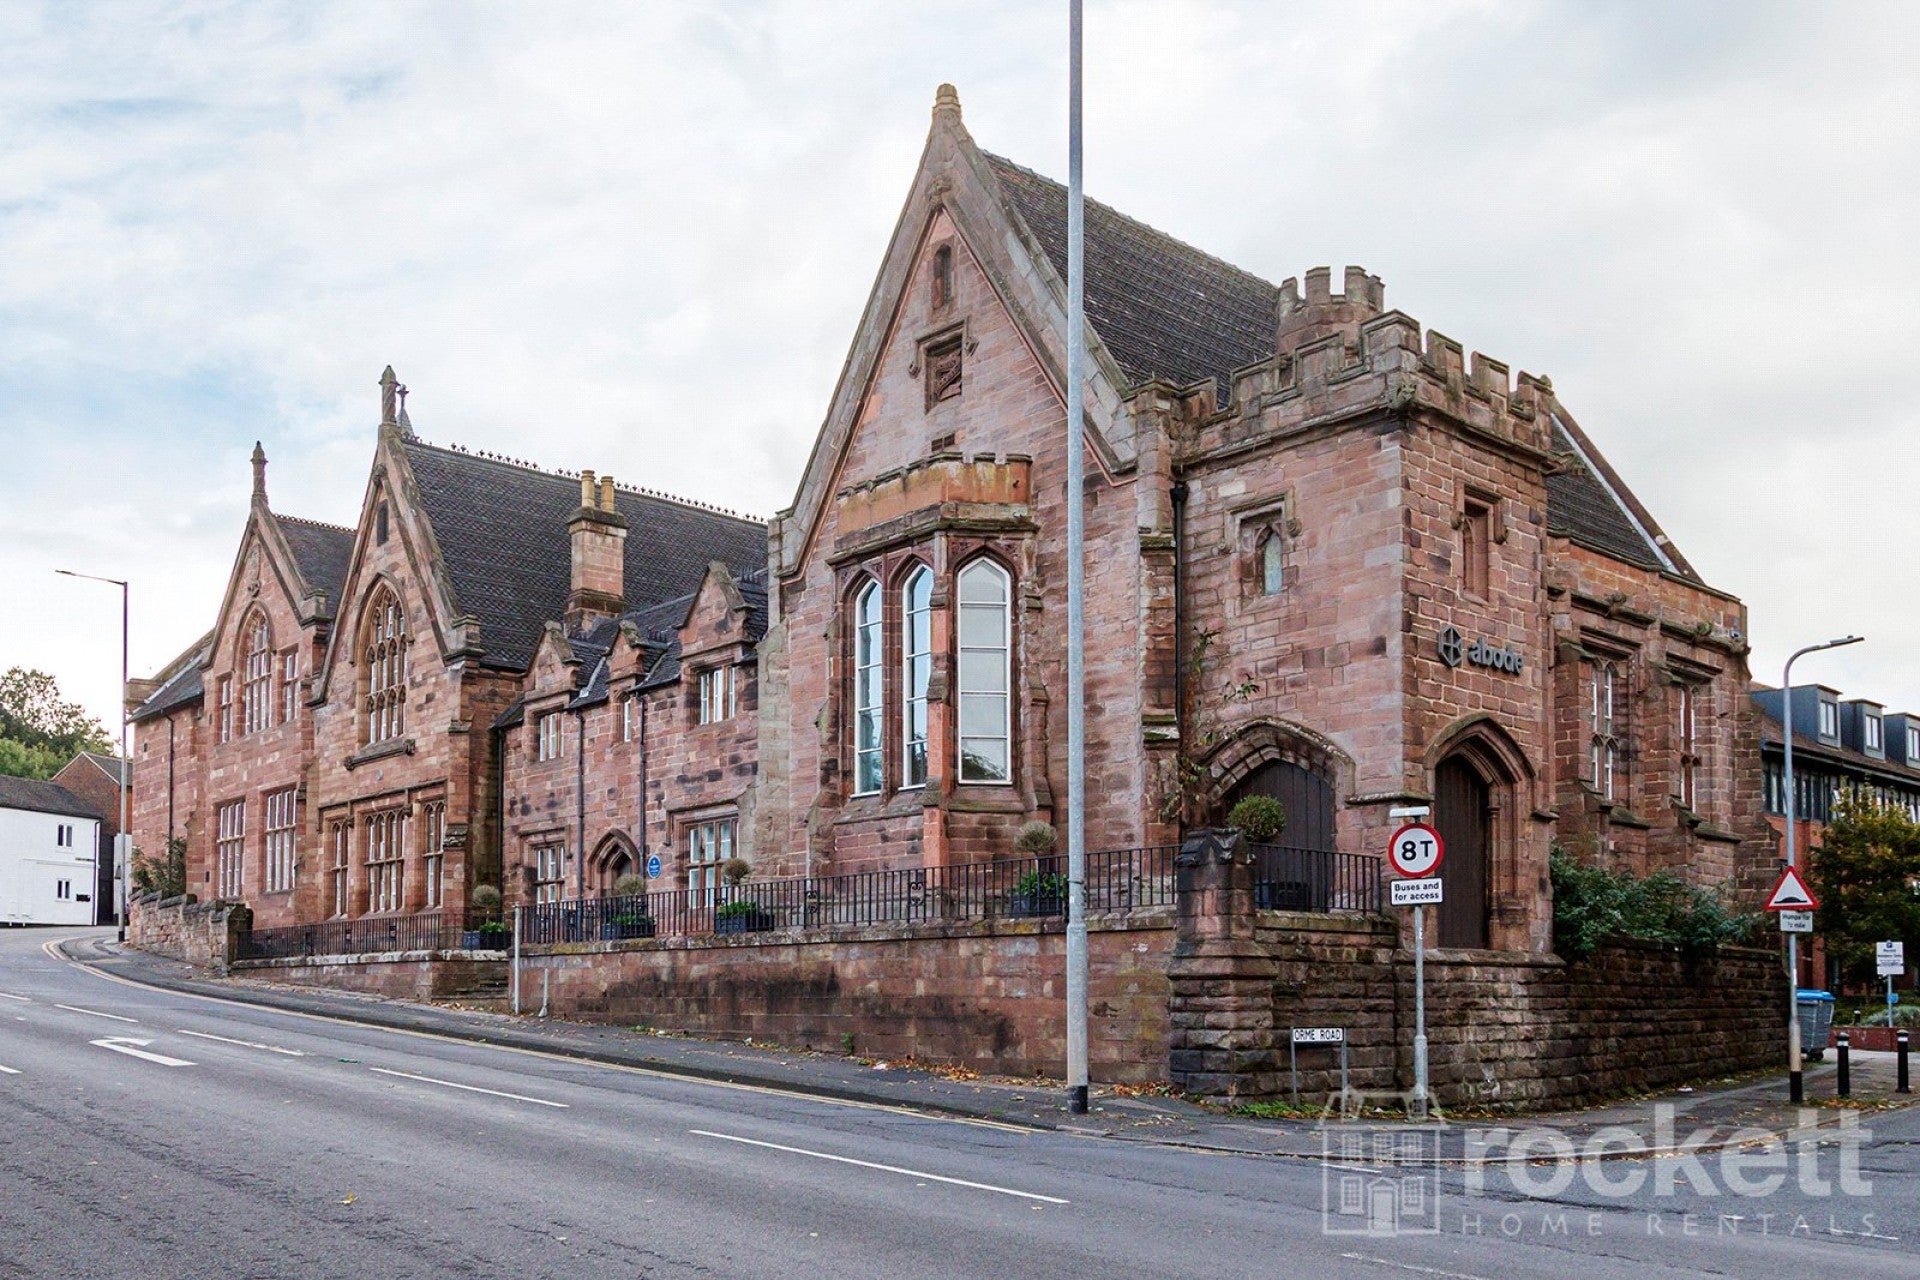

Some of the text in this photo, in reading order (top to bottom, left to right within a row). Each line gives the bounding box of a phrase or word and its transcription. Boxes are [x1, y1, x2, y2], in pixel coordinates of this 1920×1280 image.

[1468, 636, 1523, 674] abode
[1423, 882, 1439, 890] and
[1295, 1030, 1340, 1040] ORME ROAD
